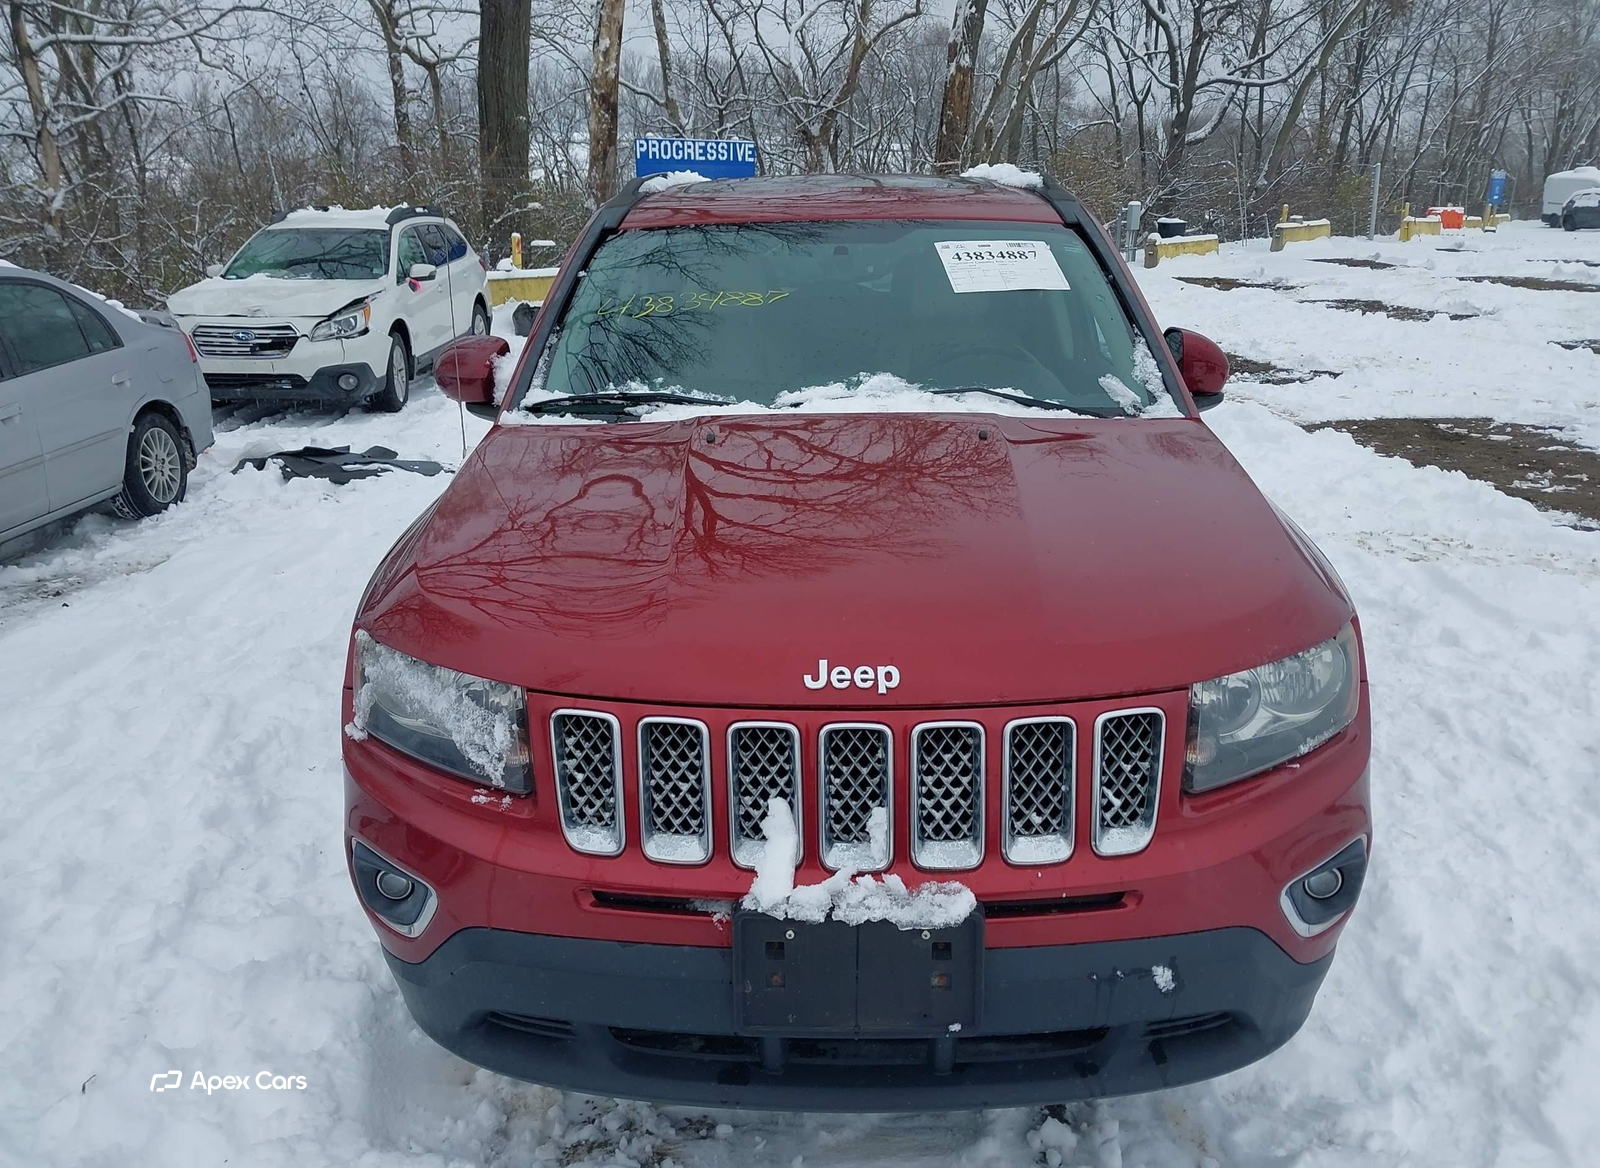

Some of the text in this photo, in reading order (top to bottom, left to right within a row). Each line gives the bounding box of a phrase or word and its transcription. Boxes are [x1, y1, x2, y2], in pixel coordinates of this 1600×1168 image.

[636, 140, 755, 162] PROGRESSIVE
[951, 250, 1037, 262] 43834887
[597, 290, 789, 321] 43834887
[803, 659, 900, 694] Jeep
